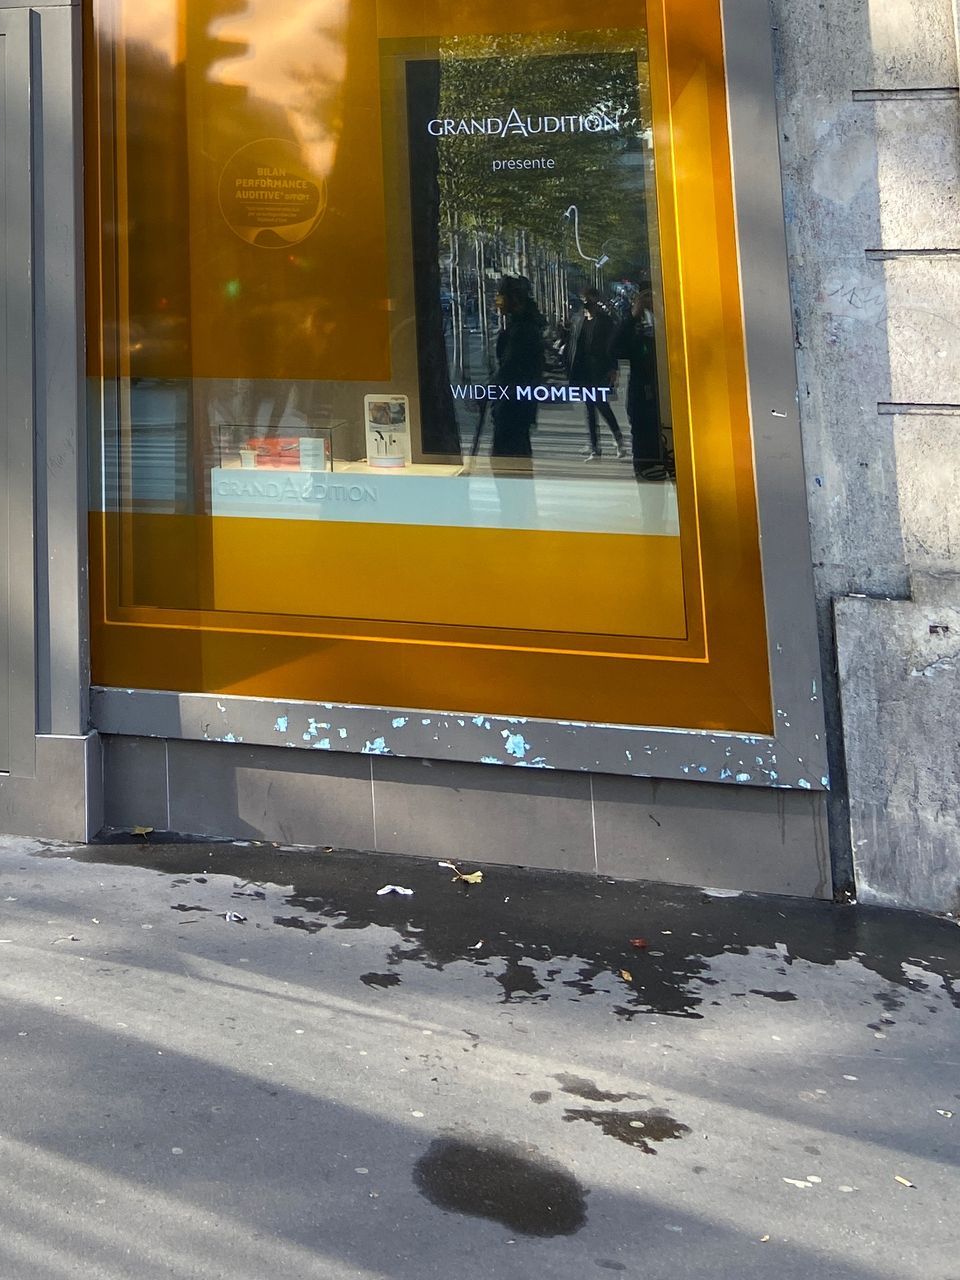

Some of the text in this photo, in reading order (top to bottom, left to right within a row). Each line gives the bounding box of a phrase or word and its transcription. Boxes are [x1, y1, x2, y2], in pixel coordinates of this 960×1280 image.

[427, 107, 620, 138] GRANDAUDITION
[256, 167, 286, 177] BILAN
[235, 178, 308, 189] PERFORMANCE
[450, 384, 611, 402] WIDEX MOMENT
